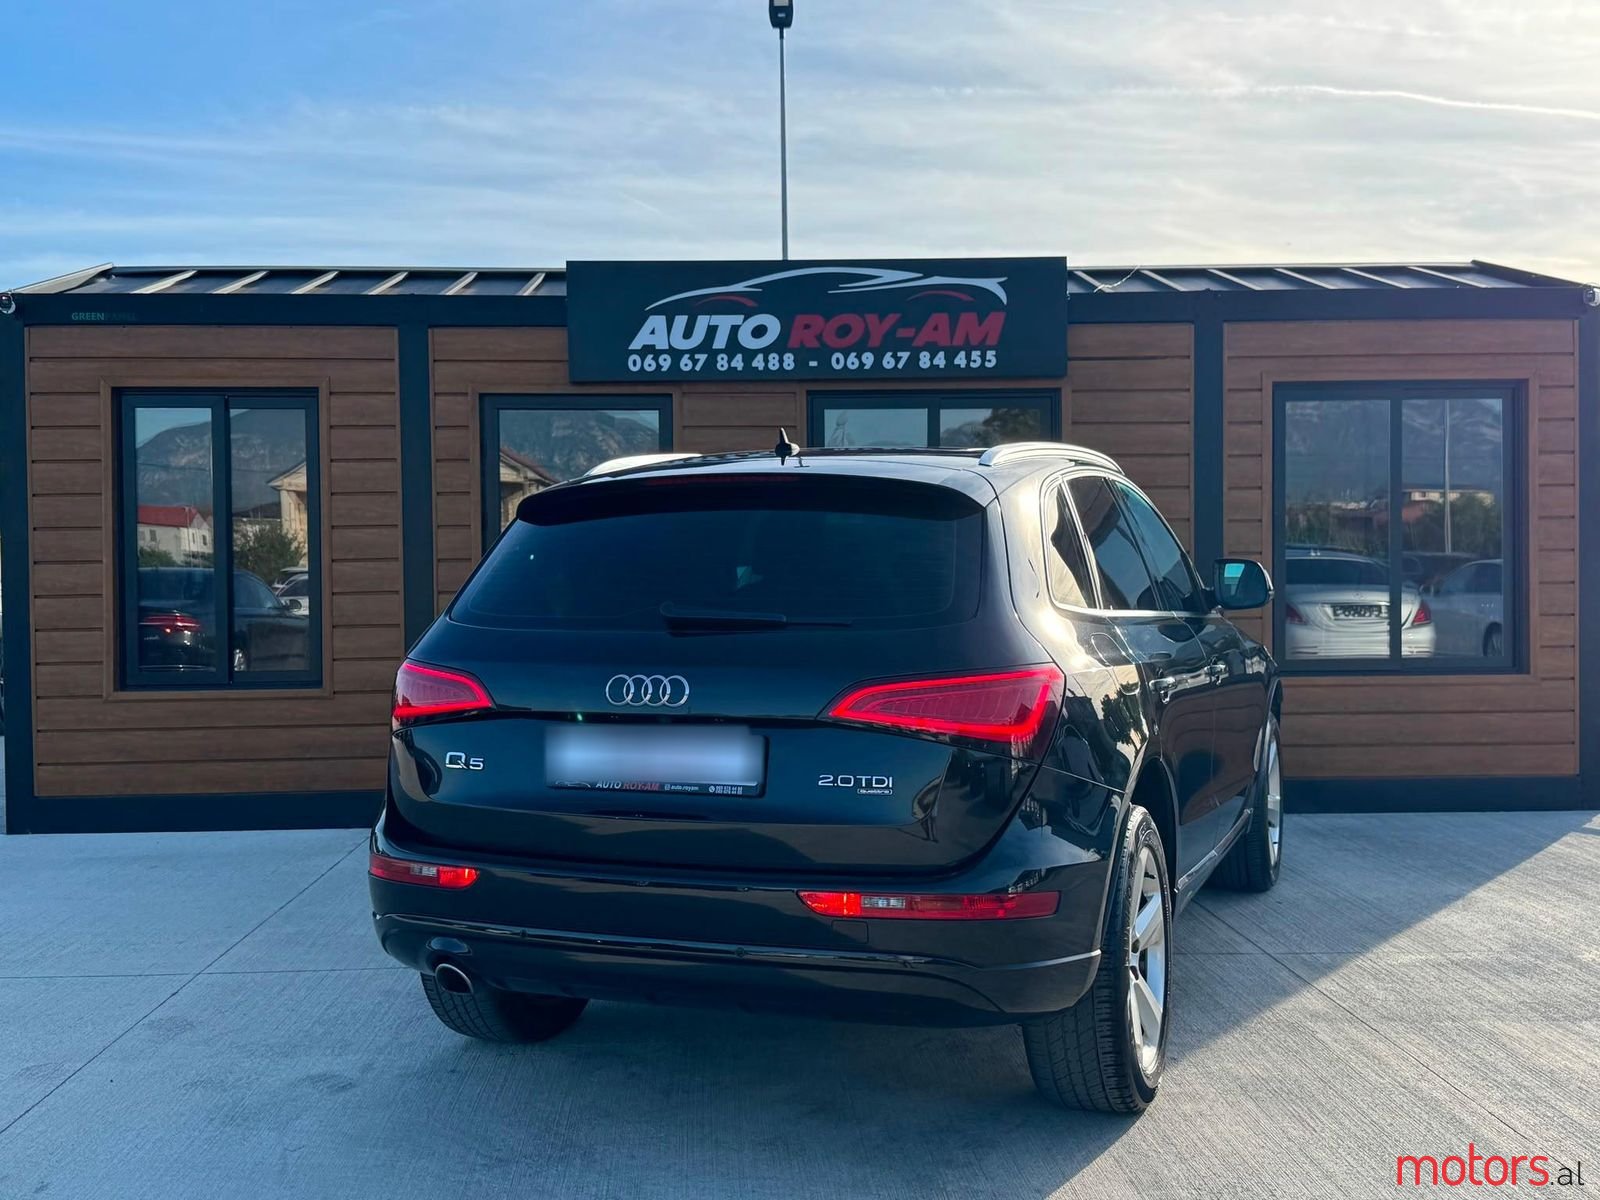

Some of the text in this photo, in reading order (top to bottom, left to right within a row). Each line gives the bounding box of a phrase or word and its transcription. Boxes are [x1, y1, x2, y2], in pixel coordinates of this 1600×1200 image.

[71, 312, 105, 321] GREEN
[628, 311, 1006, 350] AUTO ROY-AM
[628, 354, 671, 372] 069
[679, 353, 708, 372] 67
[716, 353, 744, 371] 84
[751, 353, 795, 371] 488
[831, 352, 874, 370] 069
[882, 352, 910, 370] 67
[918, 351, 946, 369] 84
[954, 350, 997, 369] 455
[445, 751, 484, 770] Q5
[595, 780, 622, 789] AUTO
